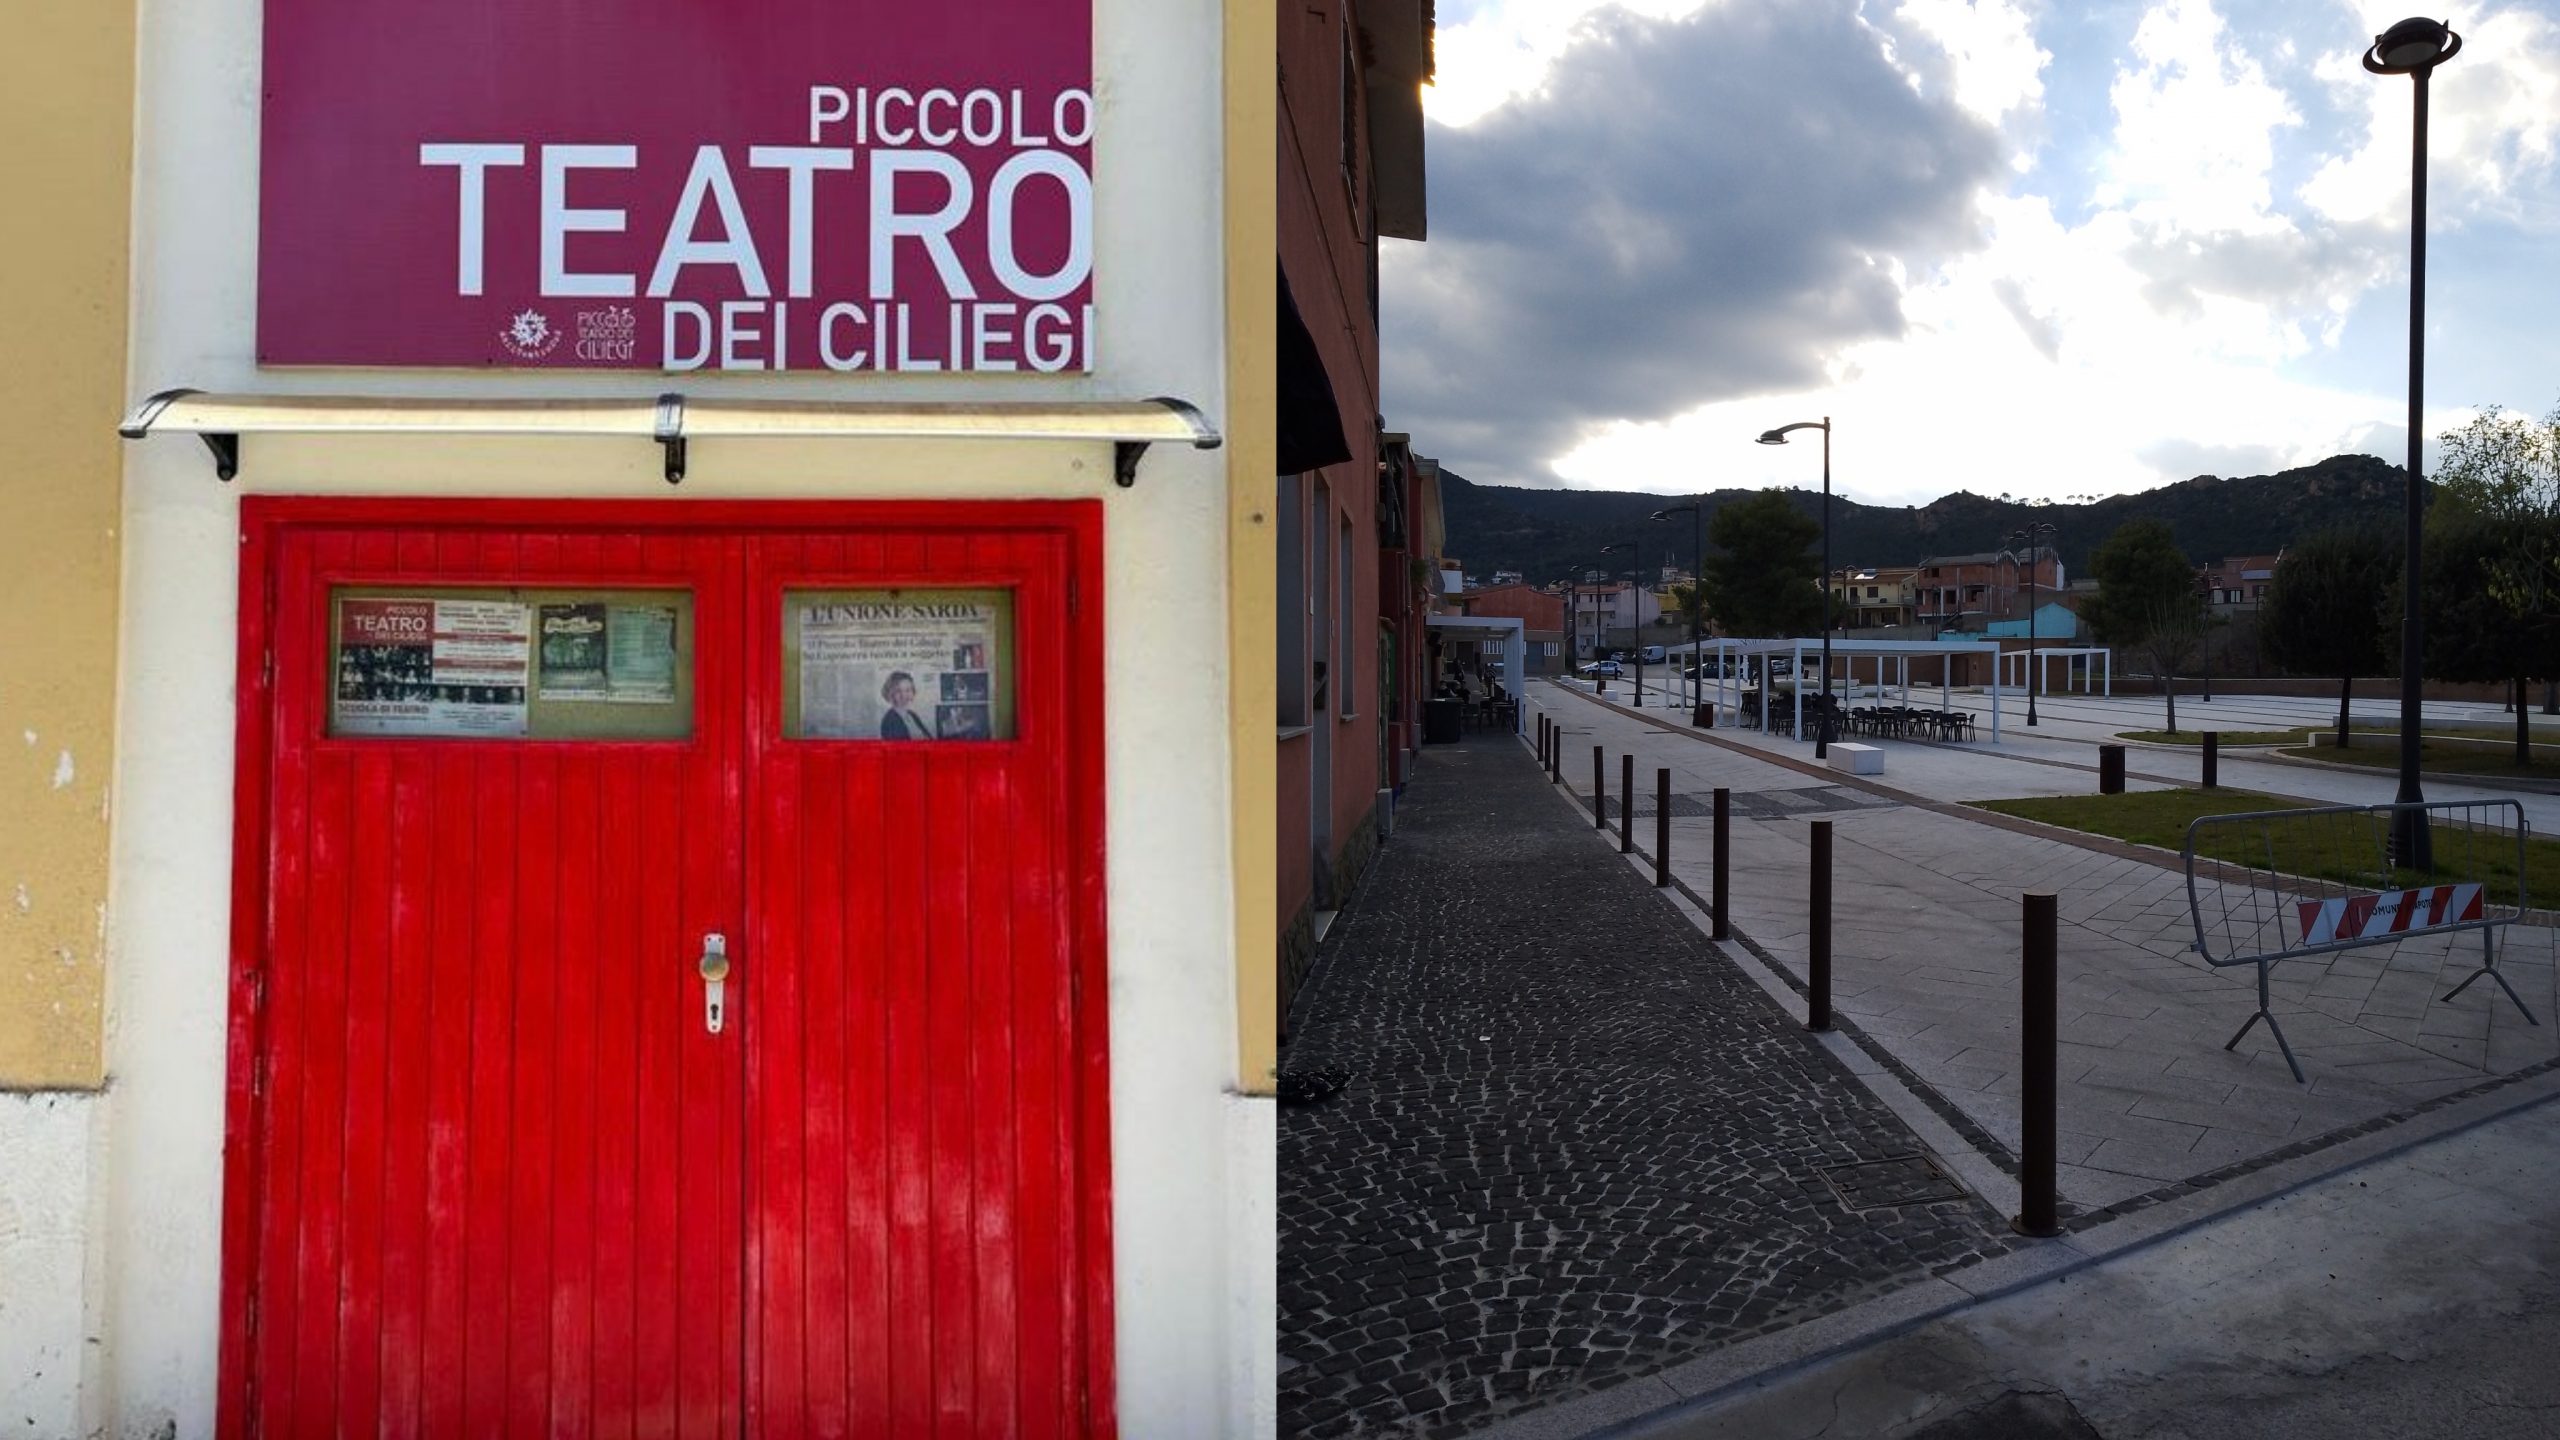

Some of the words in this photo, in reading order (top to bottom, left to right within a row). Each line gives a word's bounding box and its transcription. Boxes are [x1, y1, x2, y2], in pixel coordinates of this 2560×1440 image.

[810, 86, 1093, 147] PICCOLO
[420, 143, 1093, 300] TEATRO
[664, 301, 786, 371] DEI
[819, 302, 1093, 374] CILIEGI
[353, 615, 427, 632] TEATRO
